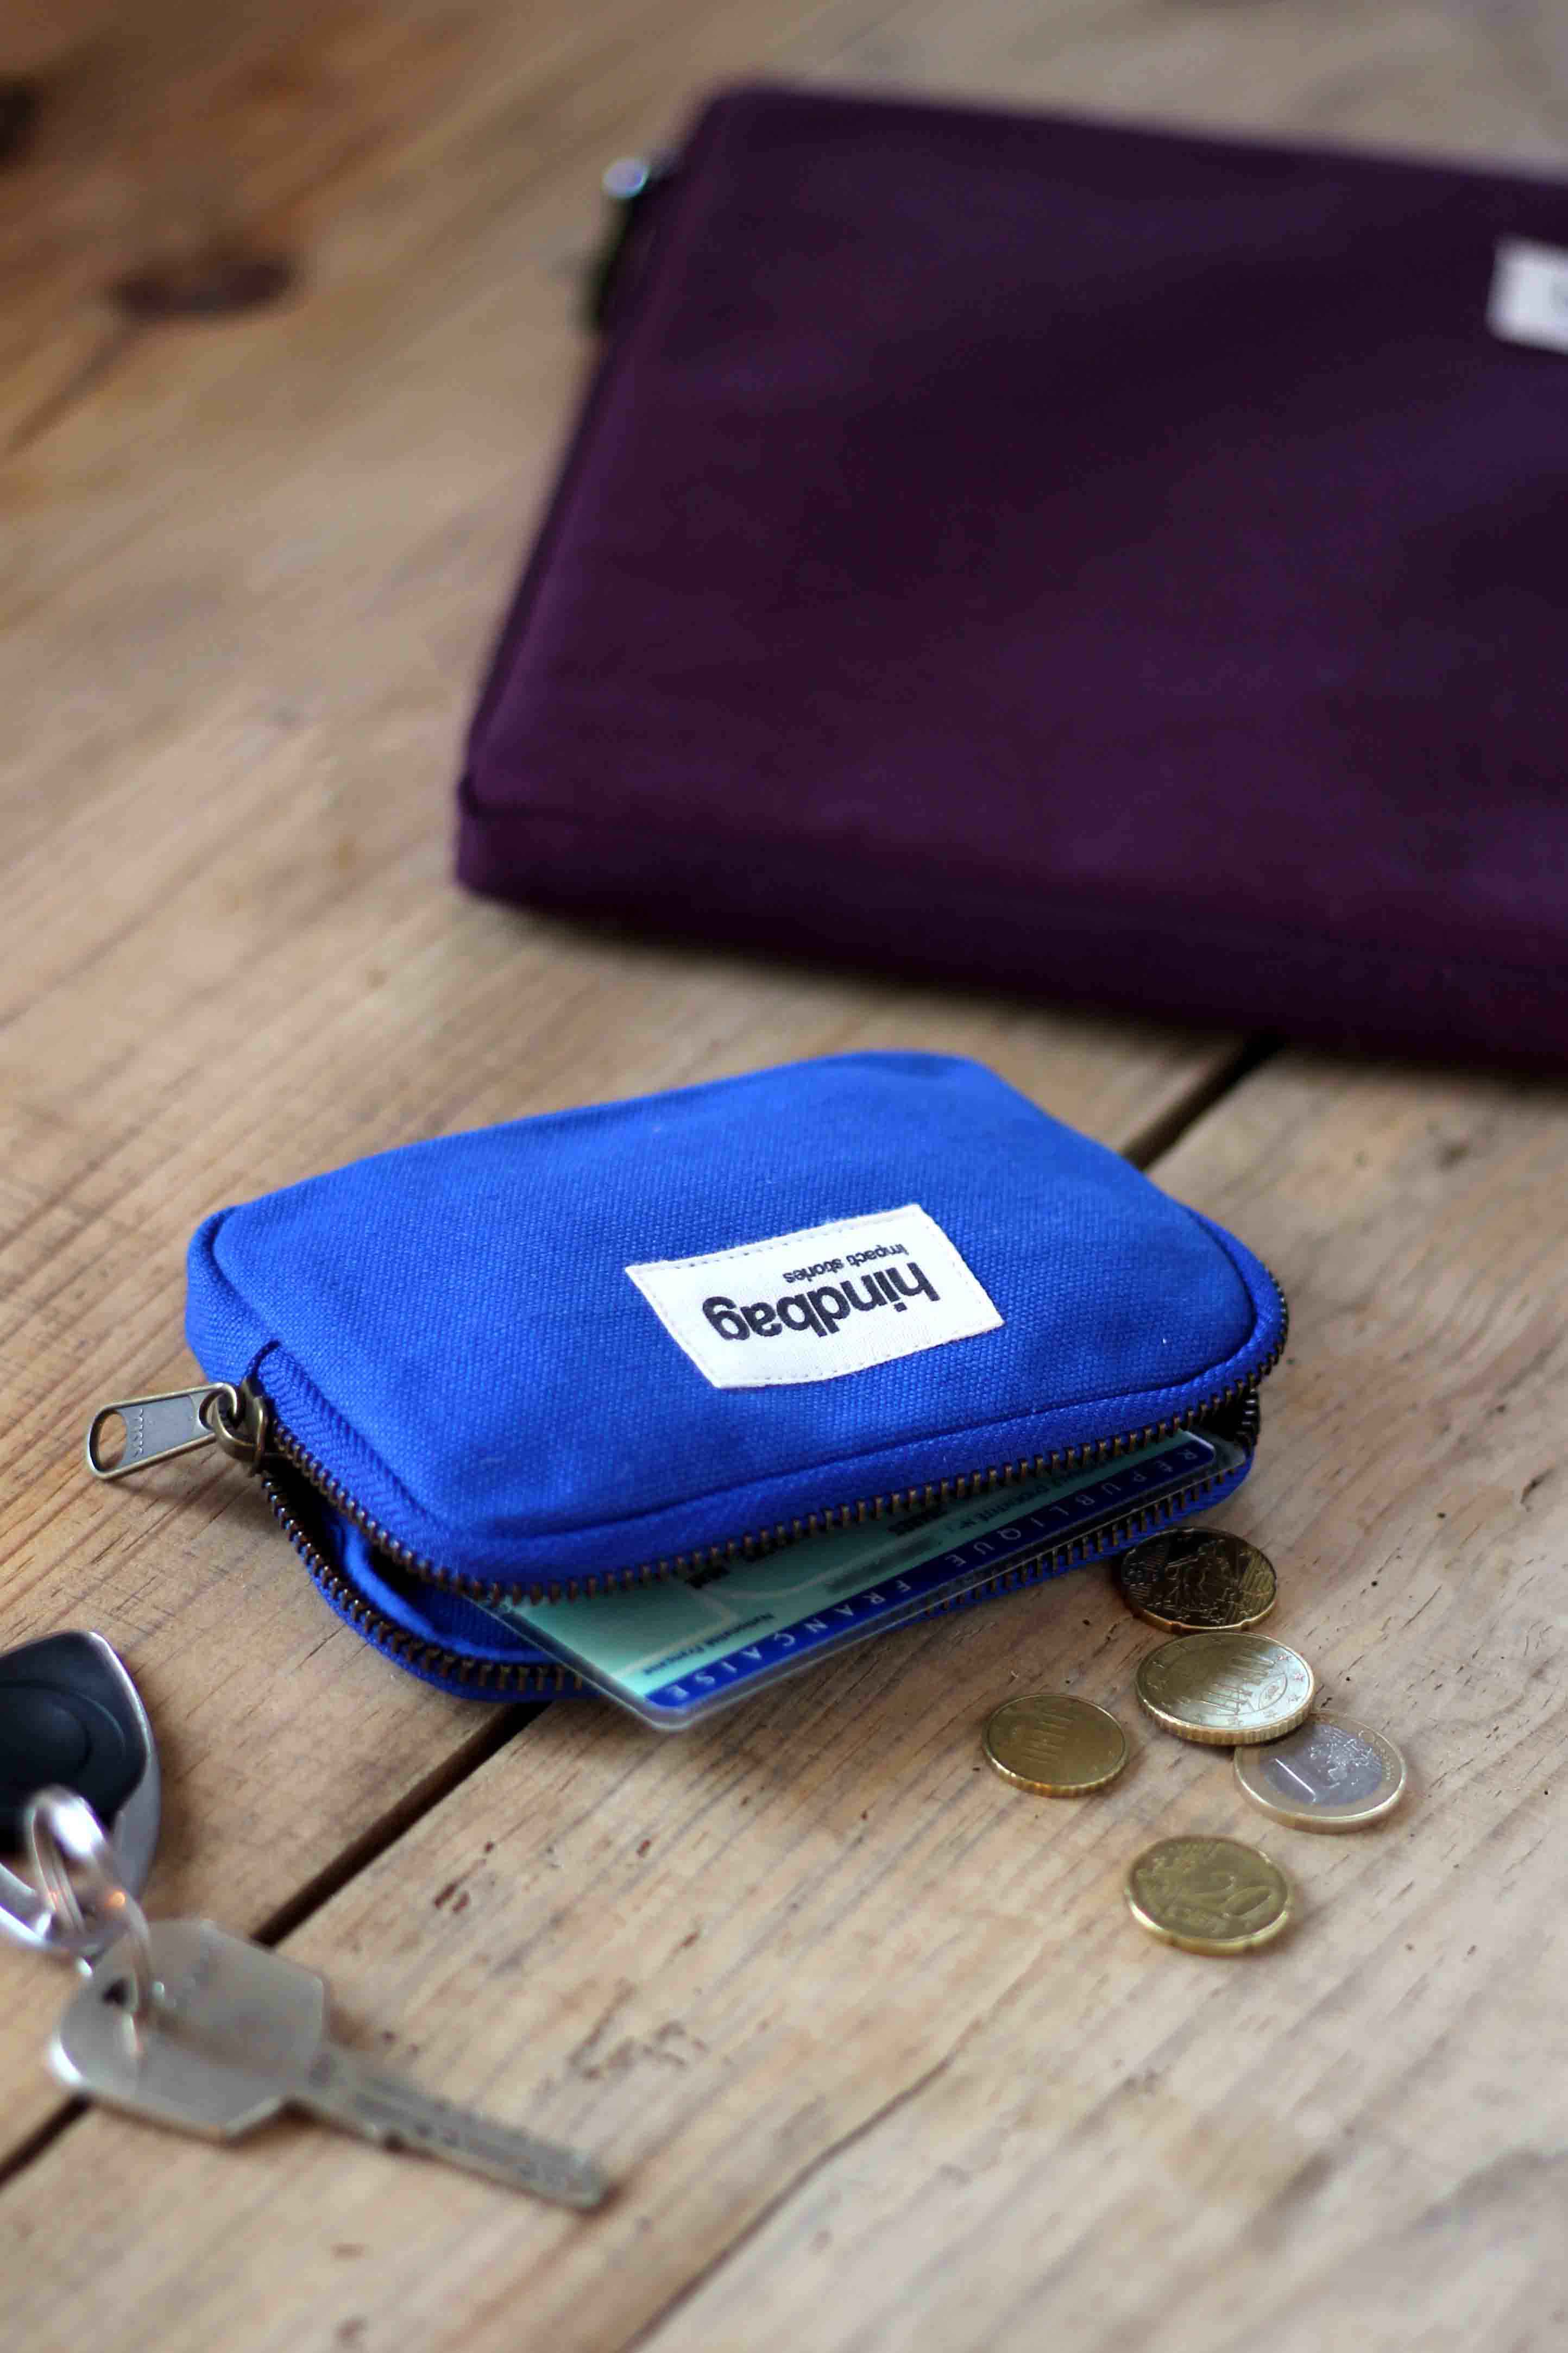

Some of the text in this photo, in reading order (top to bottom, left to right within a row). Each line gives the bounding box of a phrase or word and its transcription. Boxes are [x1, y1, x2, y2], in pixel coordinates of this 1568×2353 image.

[783, 1243, 909, 1284] impact stories
[702, 1261, 940, 1342] hindbag
